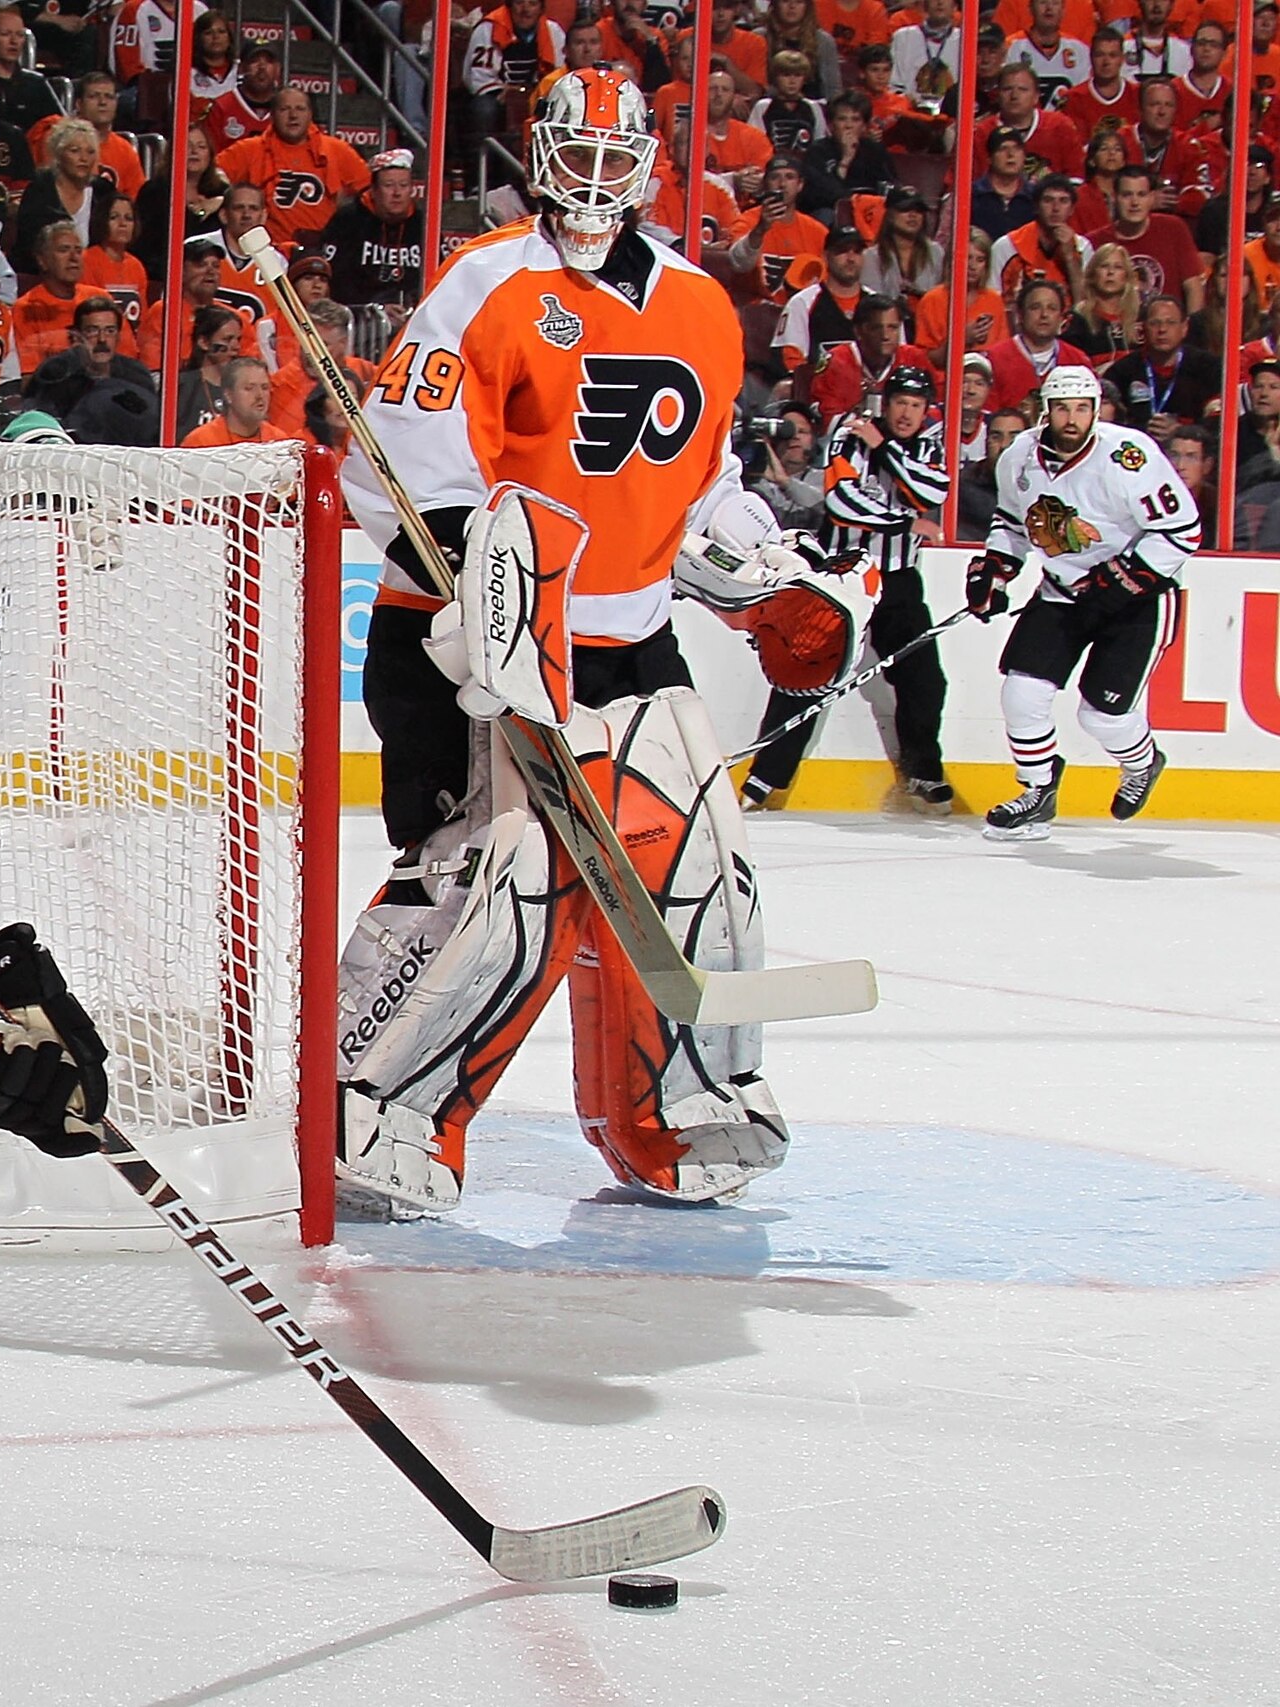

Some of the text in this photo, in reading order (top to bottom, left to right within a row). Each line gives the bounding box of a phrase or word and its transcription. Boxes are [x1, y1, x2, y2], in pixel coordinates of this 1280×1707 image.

[473, 46, 493, 68] 21
[1062, 48, 1076, 69] C
[288, 79, 343, 94] OYOT
[361, 241, 421, 268] FLYERS
[319, 356, 360, 420] Reebok
[376, 342, 466, 412] 49
[1139, 483, 1180, 523] 16
[487, 544, 511, 645] Reebok
[785, 655, 895, 732] EASTON
[623, 824, 669, 843] Reebok
[583, 855, 621, 913] Reebok
[338, 936, 435, 1066] Reebok
